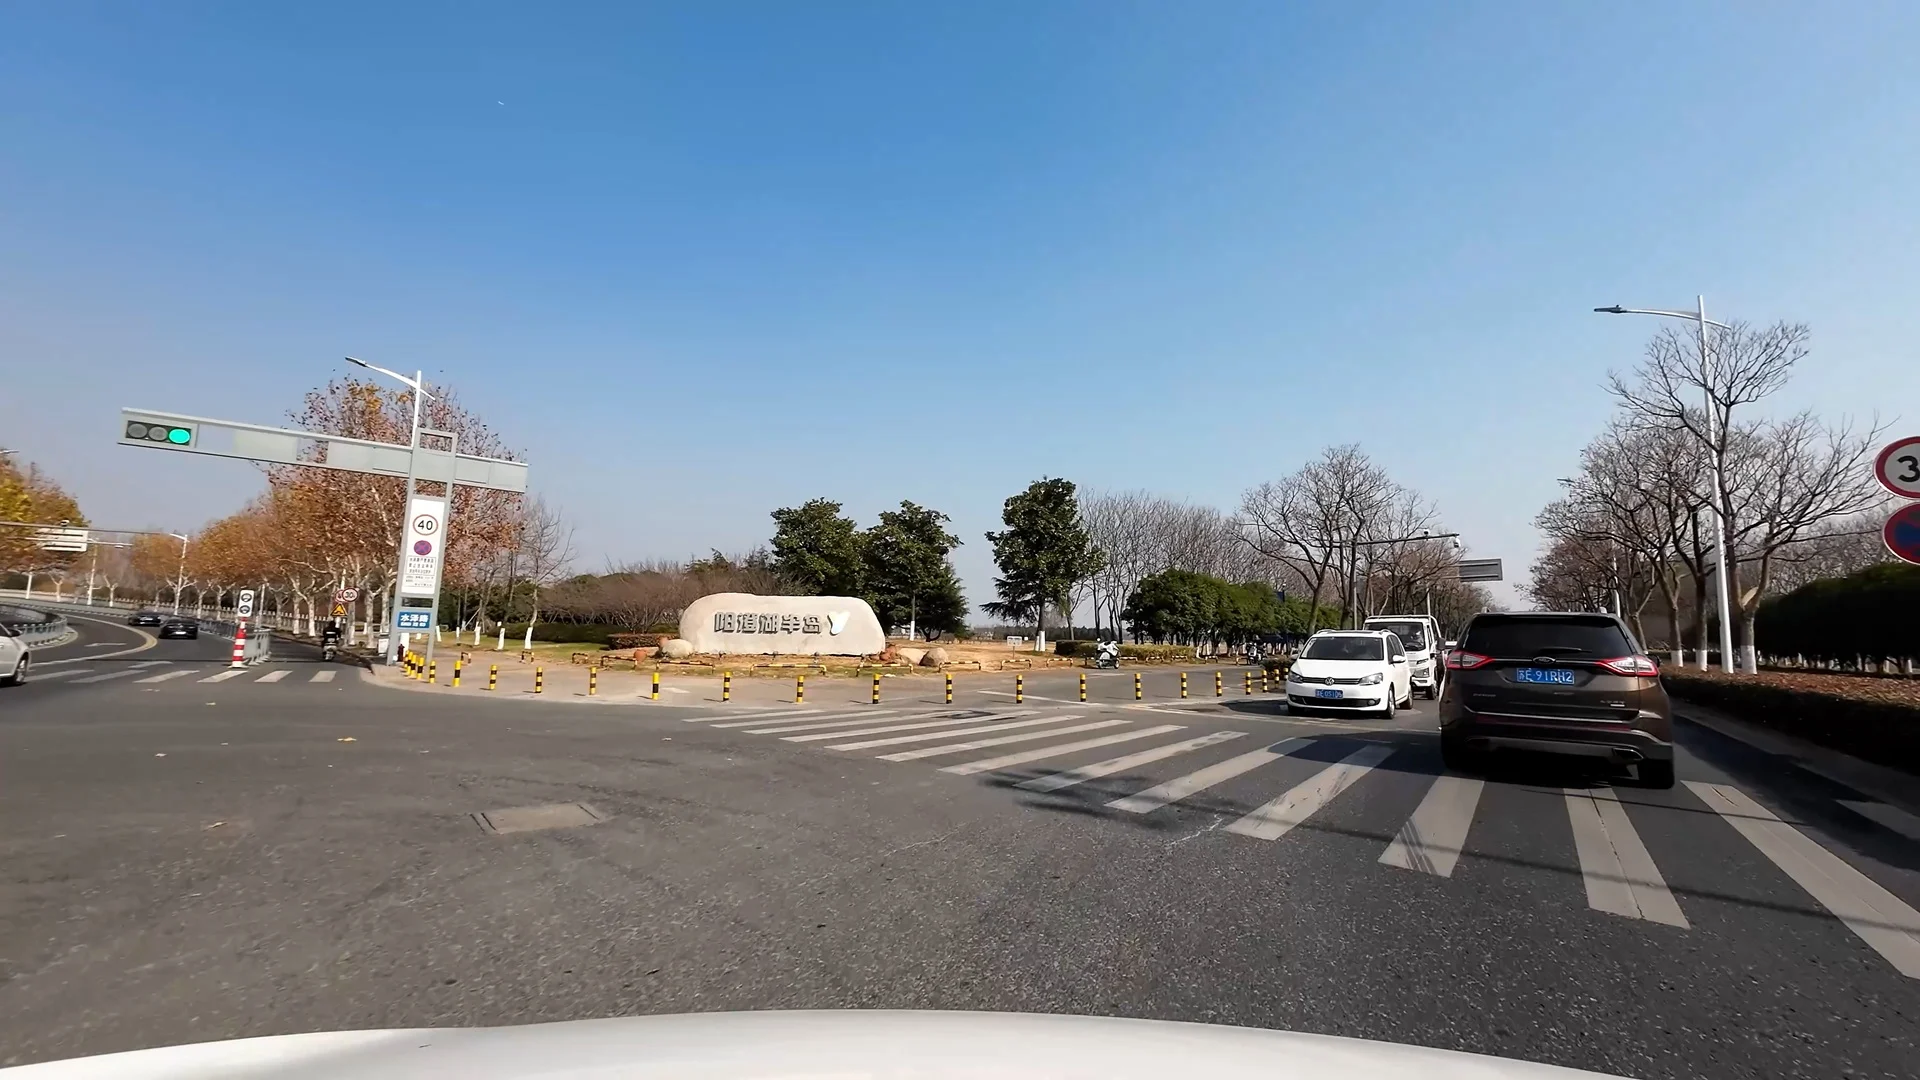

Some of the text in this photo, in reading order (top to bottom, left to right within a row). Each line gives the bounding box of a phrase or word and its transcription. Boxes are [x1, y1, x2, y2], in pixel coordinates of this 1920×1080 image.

[417, 520, 433, 531] 40
[714, 612, 822, 634] 阳澄湖半岛
